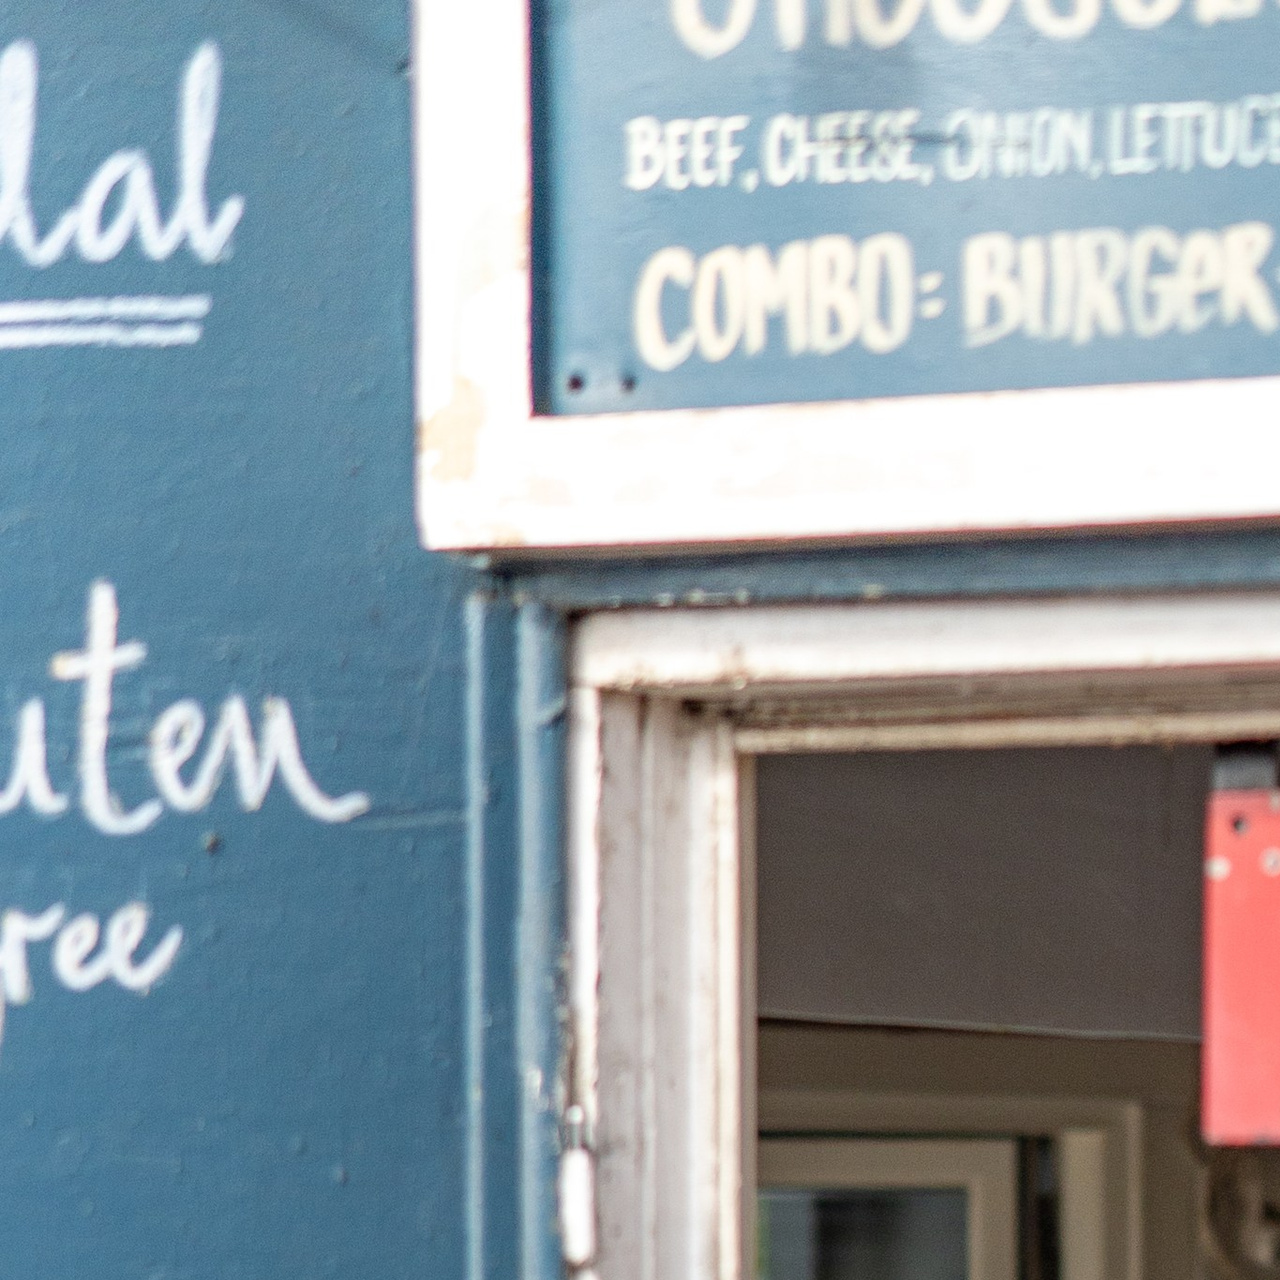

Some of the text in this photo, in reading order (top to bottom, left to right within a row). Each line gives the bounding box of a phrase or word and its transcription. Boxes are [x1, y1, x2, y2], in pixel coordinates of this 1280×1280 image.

[625, 114, 759, 194] BEEF,
[764, 106, 934, 188] CHEESE,
[944, 105, 1101, 181] ONION,
[632, 231, 946, 373] COMBO:
[0, 900, 184, 1008] ree
